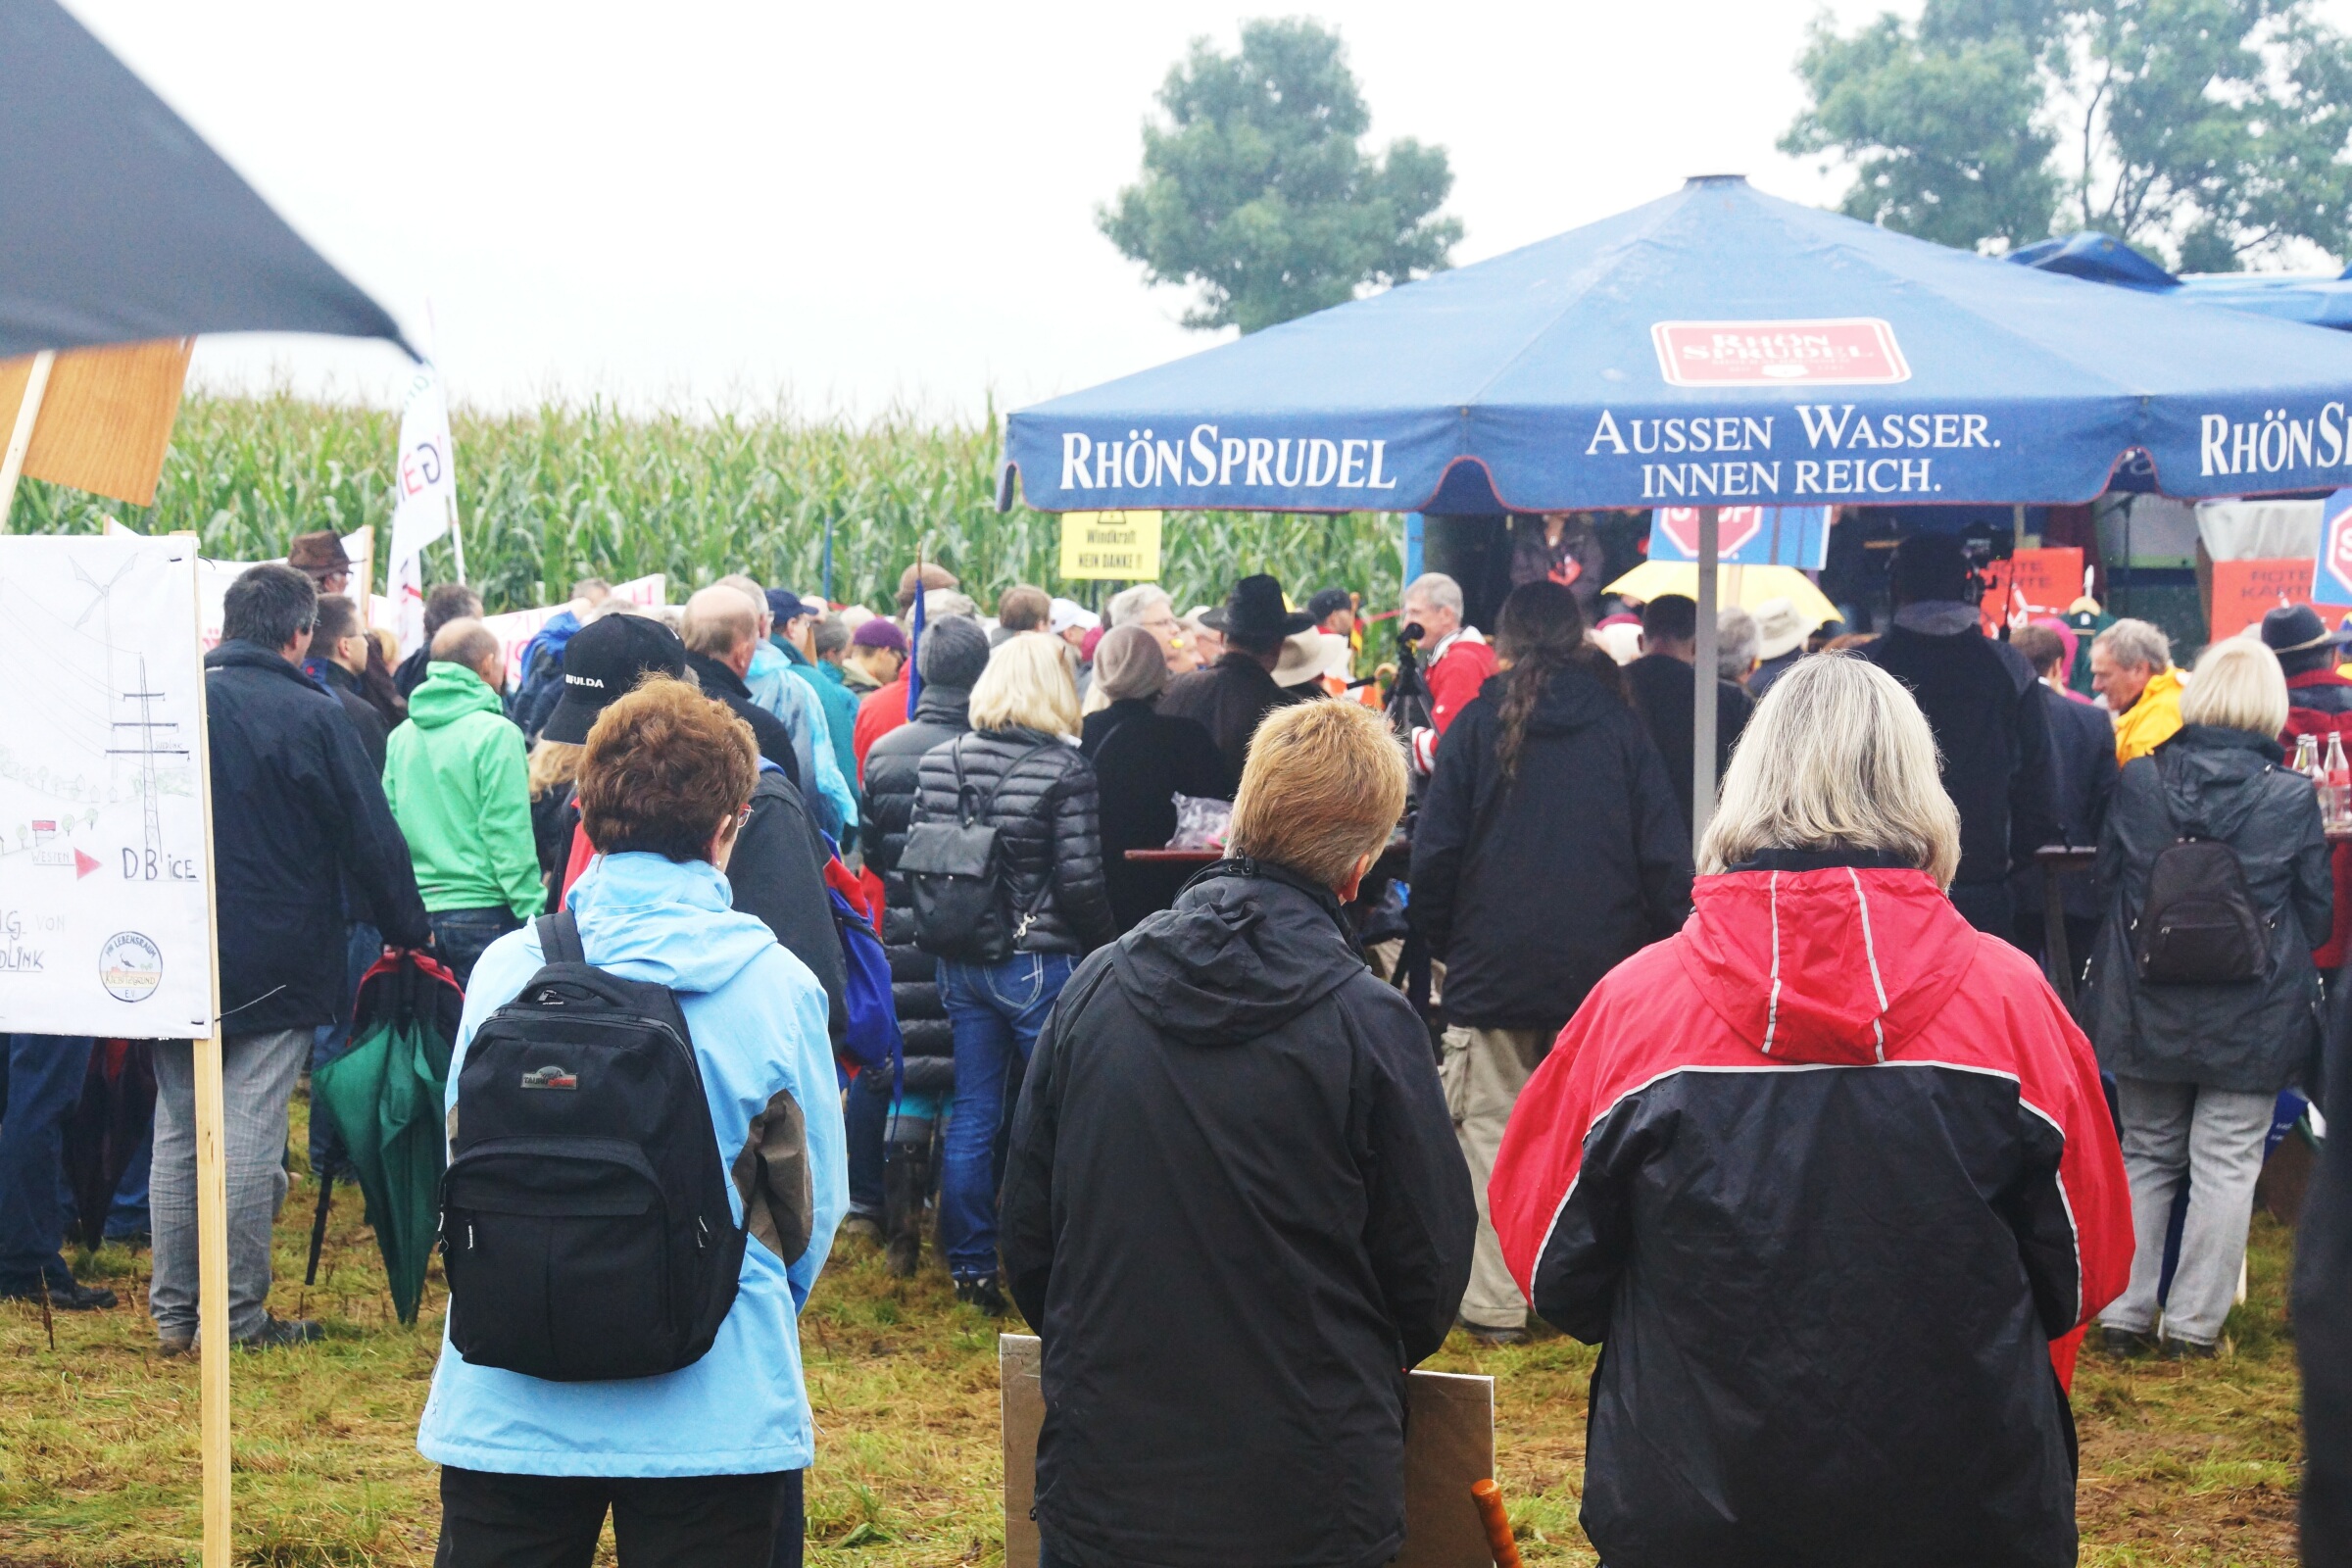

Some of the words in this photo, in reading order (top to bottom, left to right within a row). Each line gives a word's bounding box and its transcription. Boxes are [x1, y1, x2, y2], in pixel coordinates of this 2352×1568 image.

[1585, 409, 1775, 455] AUSSEN
[1794, 404, 2001, 450] WASSER.
[1060, 424, 1397, 490] RHÖNSPRUDEL
[1641, 460, 1782, 498] INNEN
[1793, 457, 1942, 495] REICH.
[31, 849, 70, 863] WESTEN
